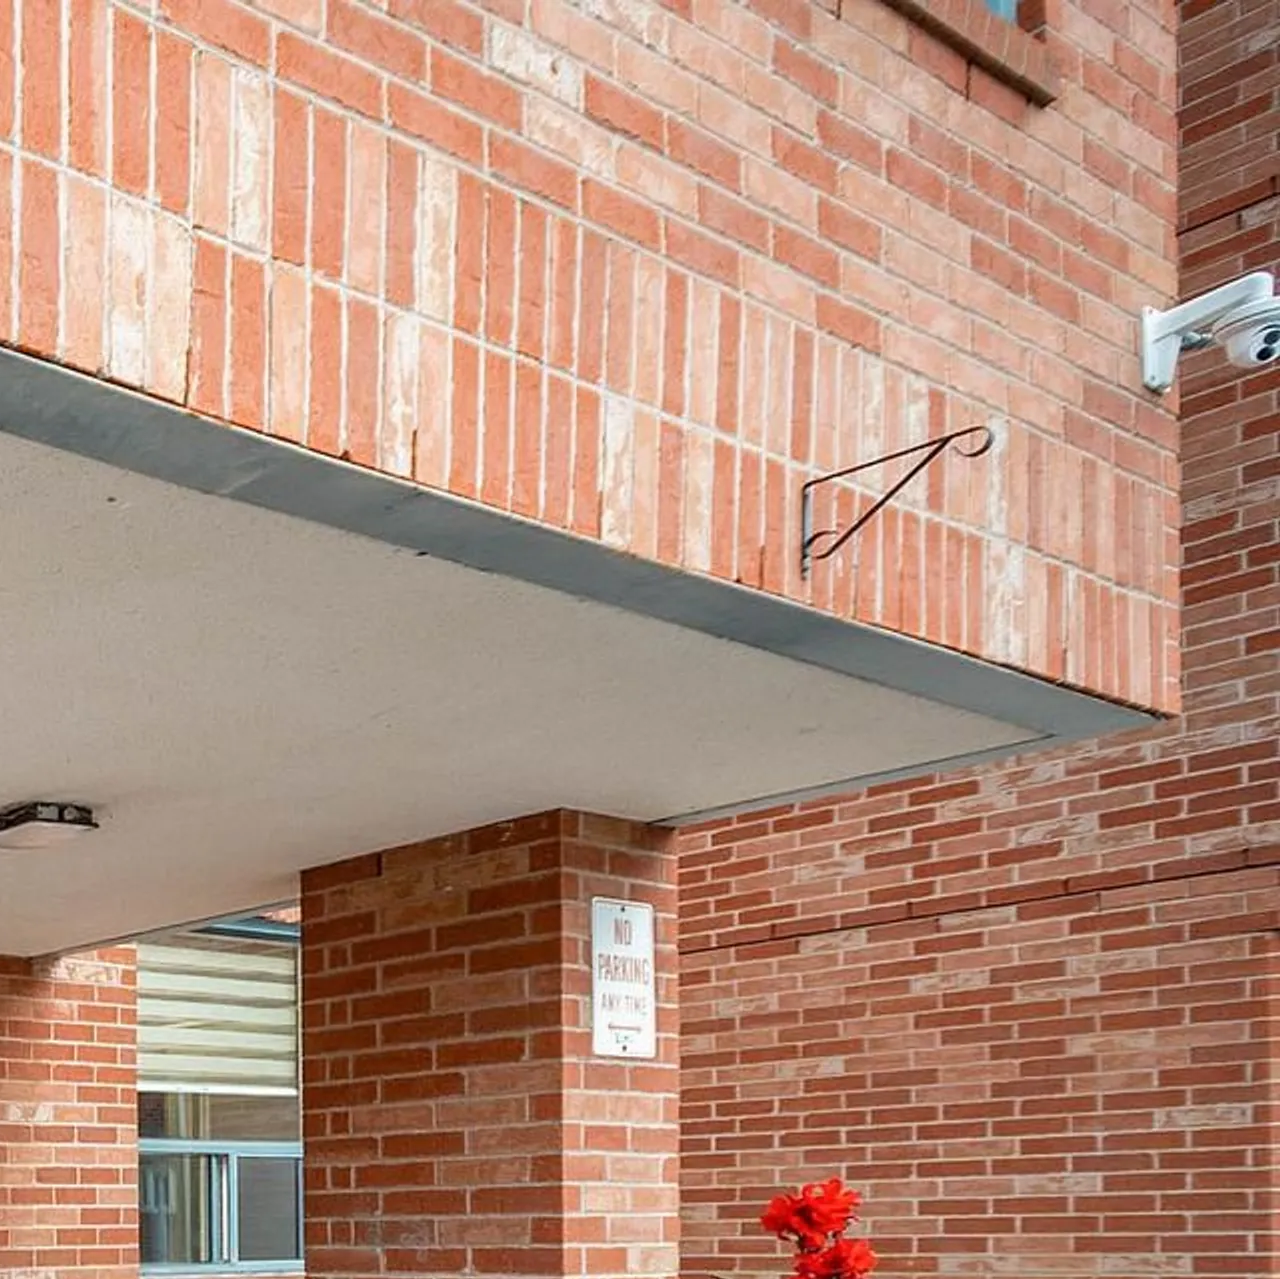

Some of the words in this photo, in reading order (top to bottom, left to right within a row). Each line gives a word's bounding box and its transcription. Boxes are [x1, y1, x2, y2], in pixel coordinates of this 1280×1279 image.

[613, 917, 633, 945] NO
[597, 953, 650, 985] PARKING
[601, 993, 622, 1010] ANY
